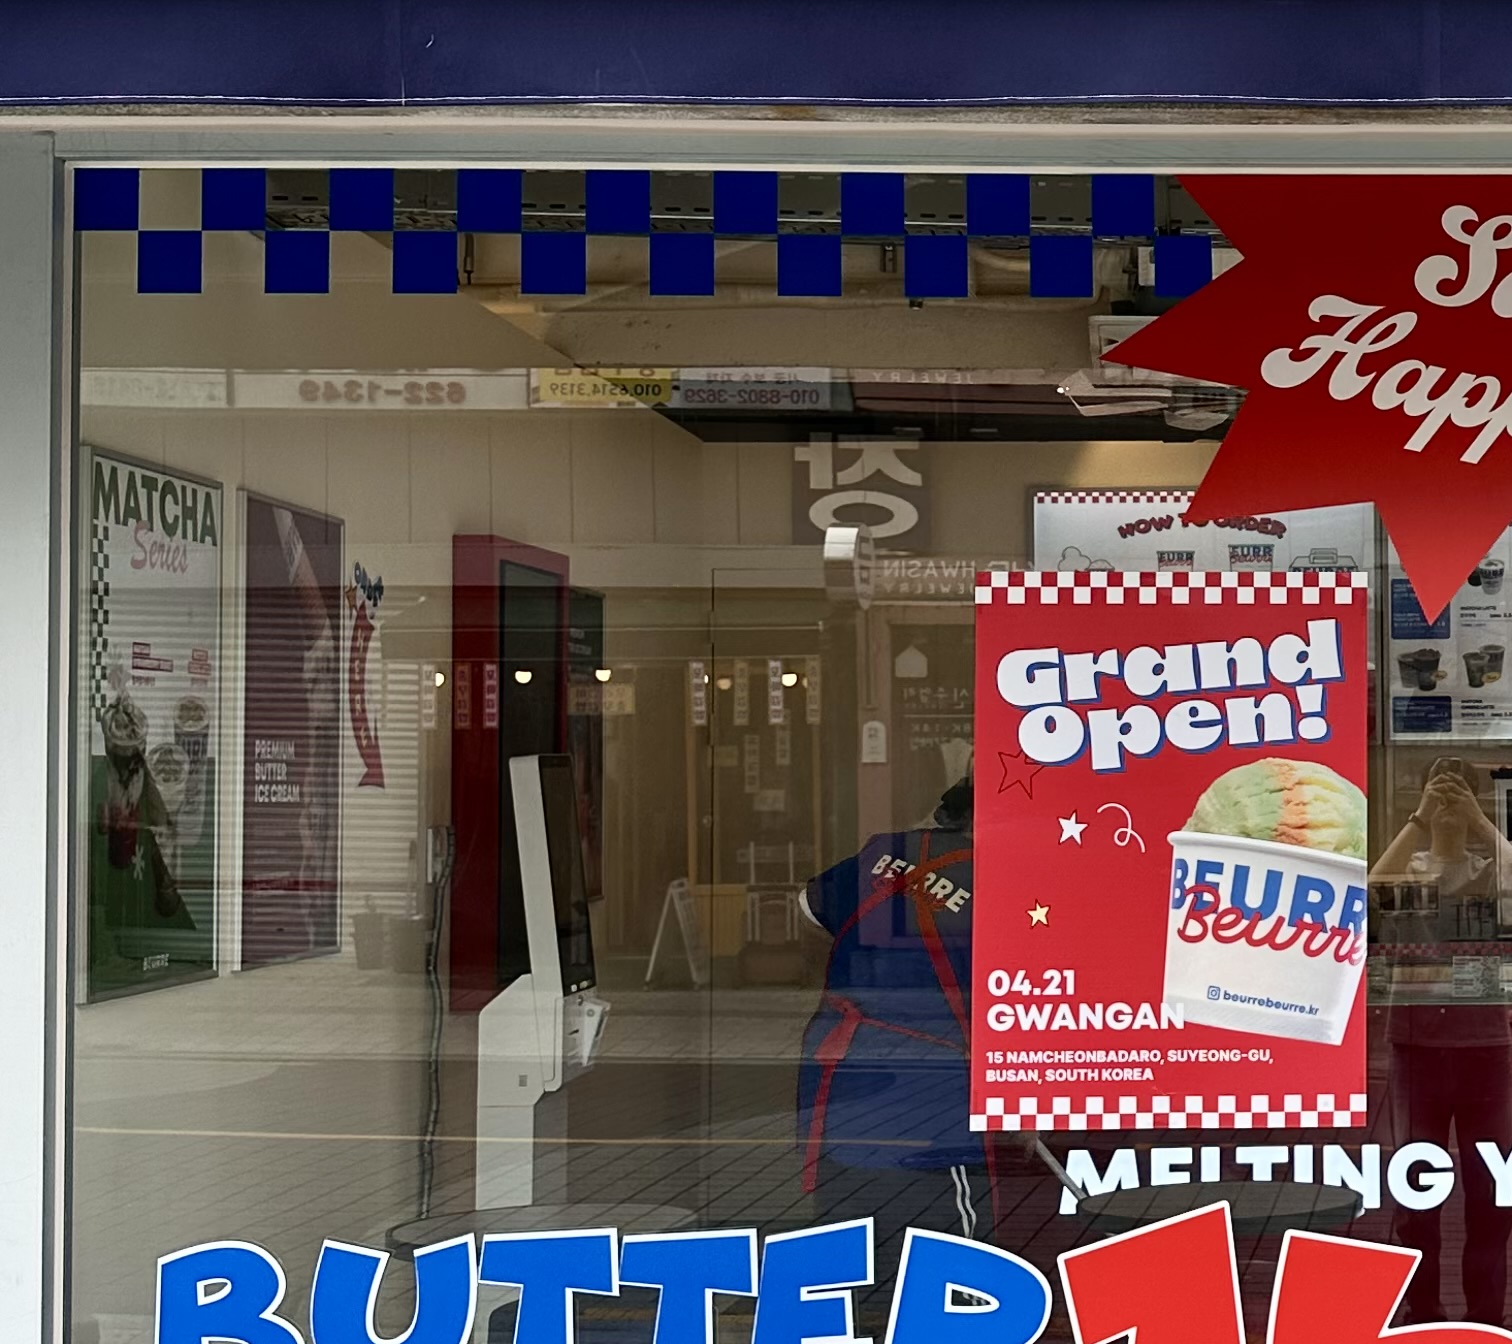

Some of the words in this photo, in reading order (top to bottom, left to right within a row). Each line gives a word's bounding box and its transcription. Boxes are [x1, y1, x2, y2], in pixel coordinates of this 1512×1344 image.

[93, 461, 217, 547] MATCHA
[130, 519, 189, 574] Series
[997, 618, 1341, 708] Grand
[1018, 685, 1330, 772] Open!
[254, 739, 296, 760] PREMIUM
[254, 762, 288, 781] BUTTER
[270, 783, 300, 803] CREAM
[987, 968, 1075, 996] 04.21
[987, 1002, 1184, 1030] GWANGAN
[1223, 987, 1319, 1017] beurrebeurre.kr
[986, 1051, 1003, 1064] 15
[1007, 1049, 1164, 1068] NAMCHEONBADARO,
[1167, 1048, 1273, 1066] SUYEONG-GU,
[986, 1069, 1041, 1084] BUSAN,
[1045, 1068, 1099, 1082] SOUTH
[1102, 1067, 1153, 1081] KOREA
